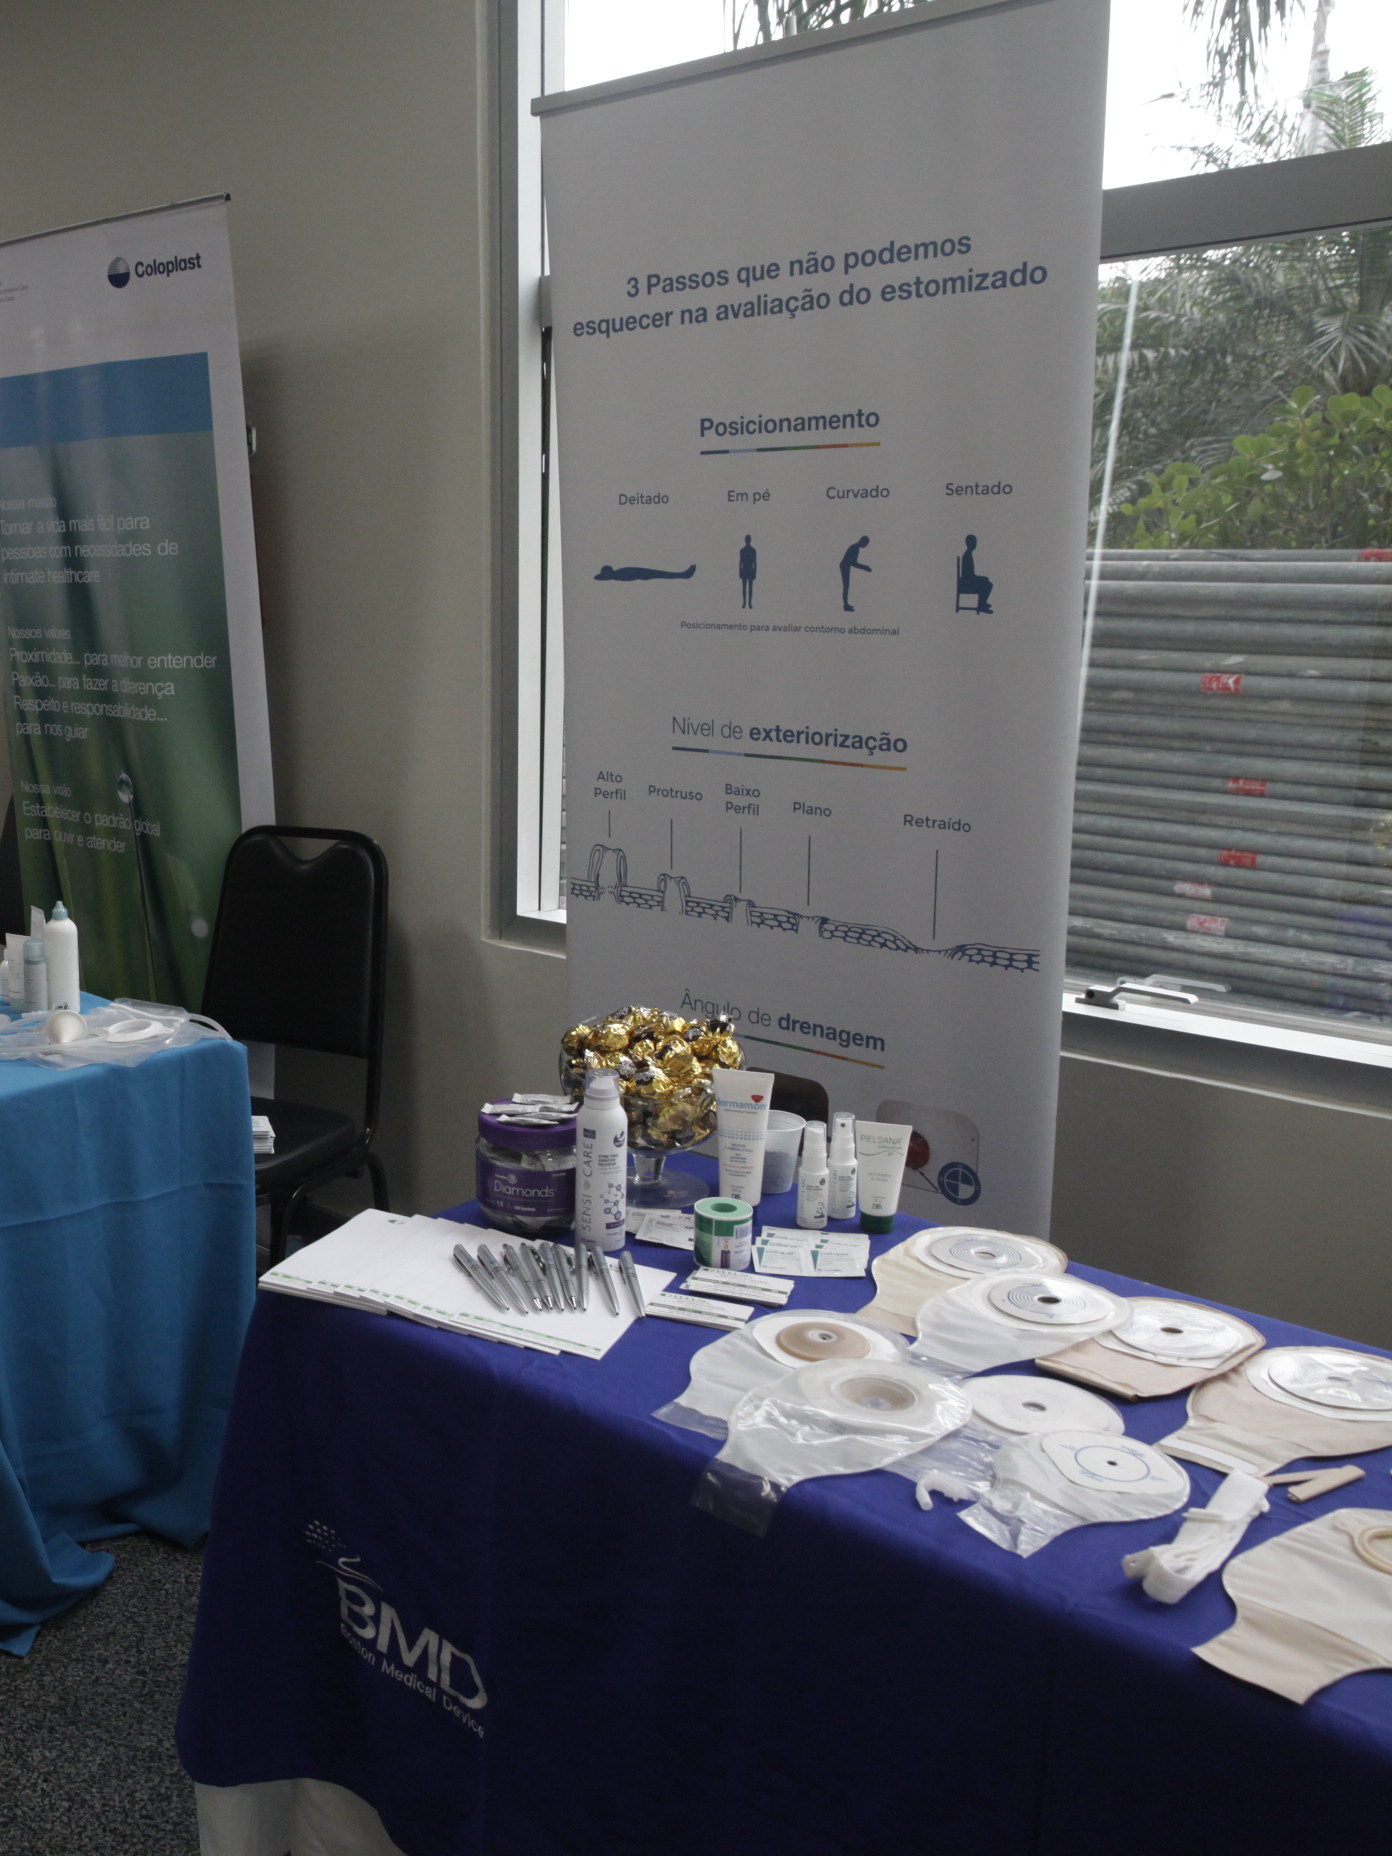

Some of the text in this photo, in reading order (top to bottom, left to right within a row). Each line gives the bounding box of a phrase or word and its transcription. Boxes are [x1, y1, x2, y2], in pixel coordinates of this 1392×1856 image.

[134, 252, 203, 279] Coloplast
[626, 235, 972, 298] 3 Passos que não podemos
[572, 260, 1049, 338] esquecer na avaliação do estomizado
[699, 407, 881, 438] Posicionamento
[727, 487, 771, 505] Em pé
[825, 484, 891, 500] Curvado
[944, 480, 1014, 497] Sentado
[617, 492, 670, 506] Deitado
[37, 521, 44, 534] a
[69, 514, 95, 532] mais
[117, 515, 150, 534] para
[1, 538, 179, 563] pessoas com necessidades de
[3, 567, 101, 584] intimate healthcare
[8, 626, 42, 640] Nossos
[680, 621, 900, 636] Posicionamento para avaliar contorno abdominal
[84, 652, 108, 668] para
[147, 651, 217, 670] entender
[58, 677, 80, 691] para
[83, 674, 108, 692] fazer
[112, 680, 118, 692] a
[14, 696, 60, 714] Respeito
[62, 702, 68, 712] e
[16, 721, 88, 741] para nos guiar
[671, 716, 908, 756] Nível de exteriorização
[597, 770, 623, 784] Alto
[20, 781, 51, 795] Nossa
[593, 786, 627, 801] Perfil
[648, 784, 703, 801] Protruso
[724, 783, 761, 798] Baixo
[725, 801, 760, 817] Perfil
[792, 801, 832, 818] Plano
[22, 801, 161, 837] Estabelecer o padrão global
[903, 813, 972, 833] Retraído
[25, 827, 51, 840] para
[77, 835, 84, 847] e
[86, 834, 127, 853] atender
[680, 988, 886, 1052] Ângulo de drenagem
[583, 1142, 593, 1178] CARE
[494, 1180, 555, 1198] Diamonds
[336, 1576, 488, 1709] BMD
[381, 1659, 436, 1703] Medical
